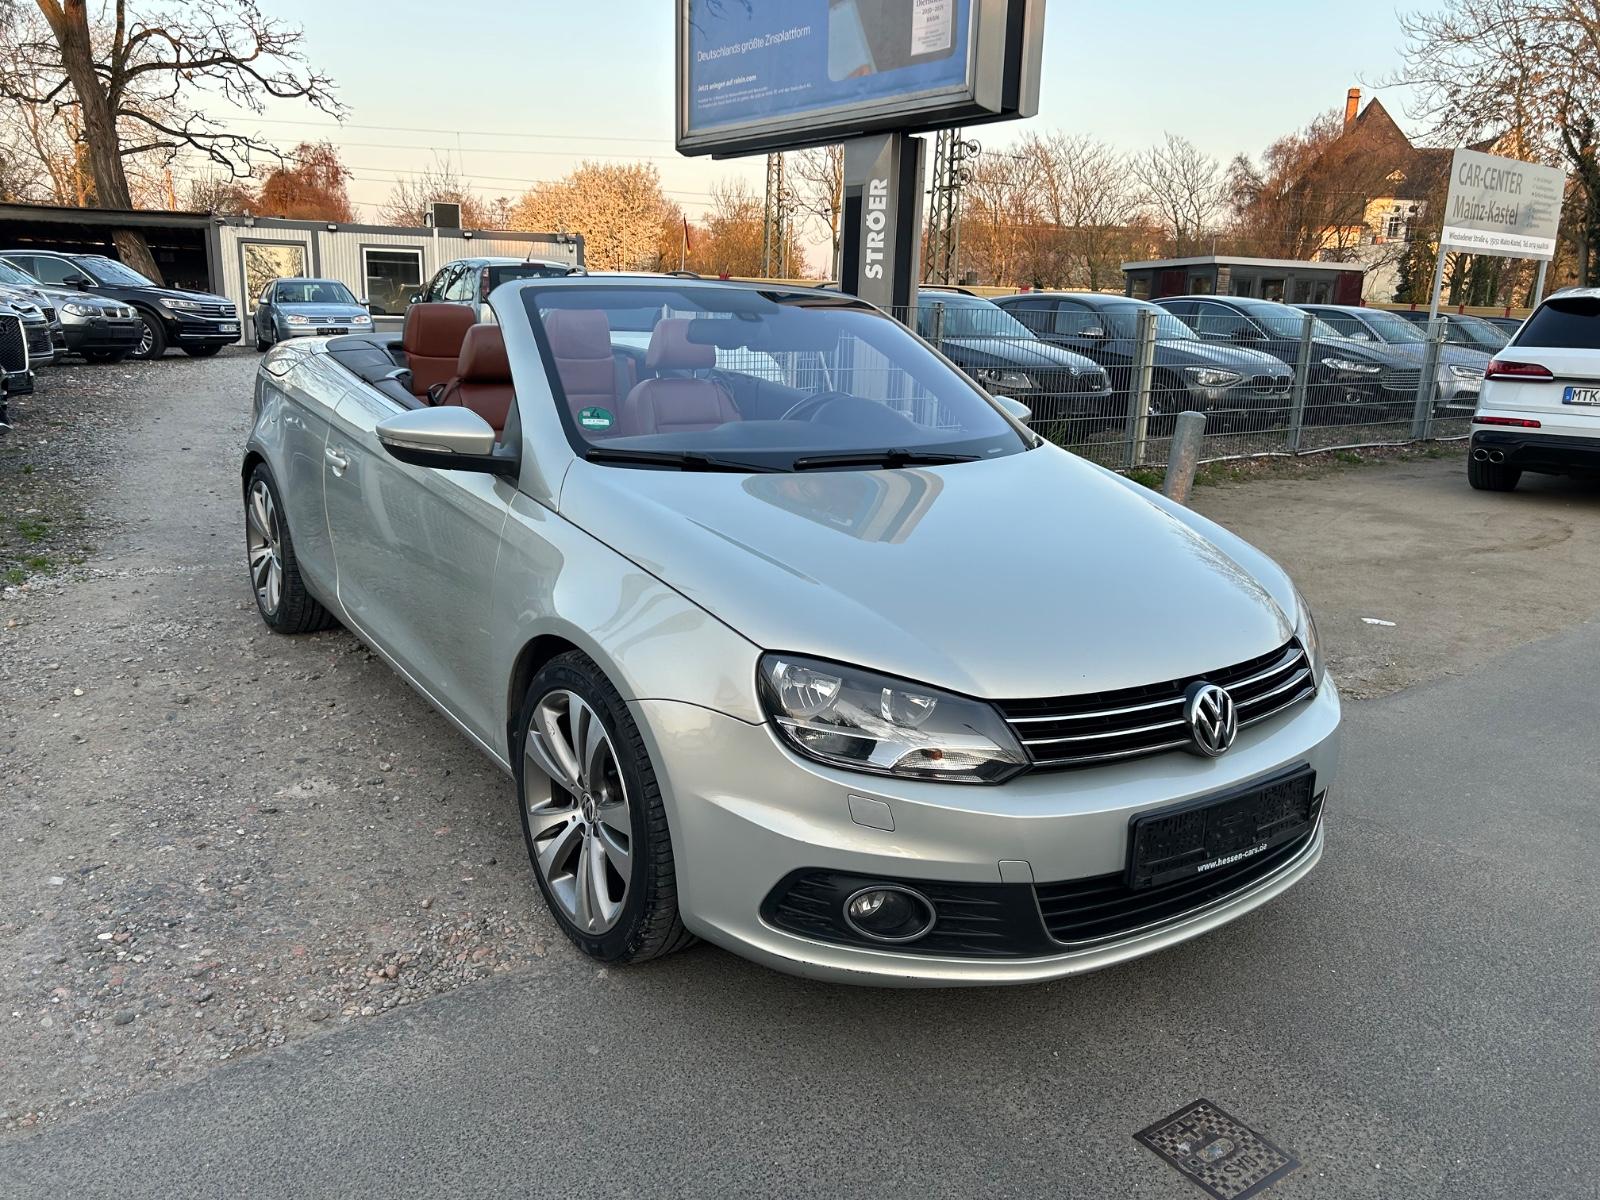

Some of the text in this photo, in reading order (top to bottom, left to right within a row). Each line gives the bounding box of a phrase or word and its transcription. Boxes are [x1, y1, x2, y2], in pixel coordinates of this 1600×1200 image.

[697, 26, 811, 62] Deutschlands größte Zinsplattform
[1458, 162, 1523, 195] CAR-CENTER
[1453, 195, 1519, 225] Mainz-Kastel
[865, 178, 888, 279] STRÖER
[1572, 389, 1599, 402] MTK
